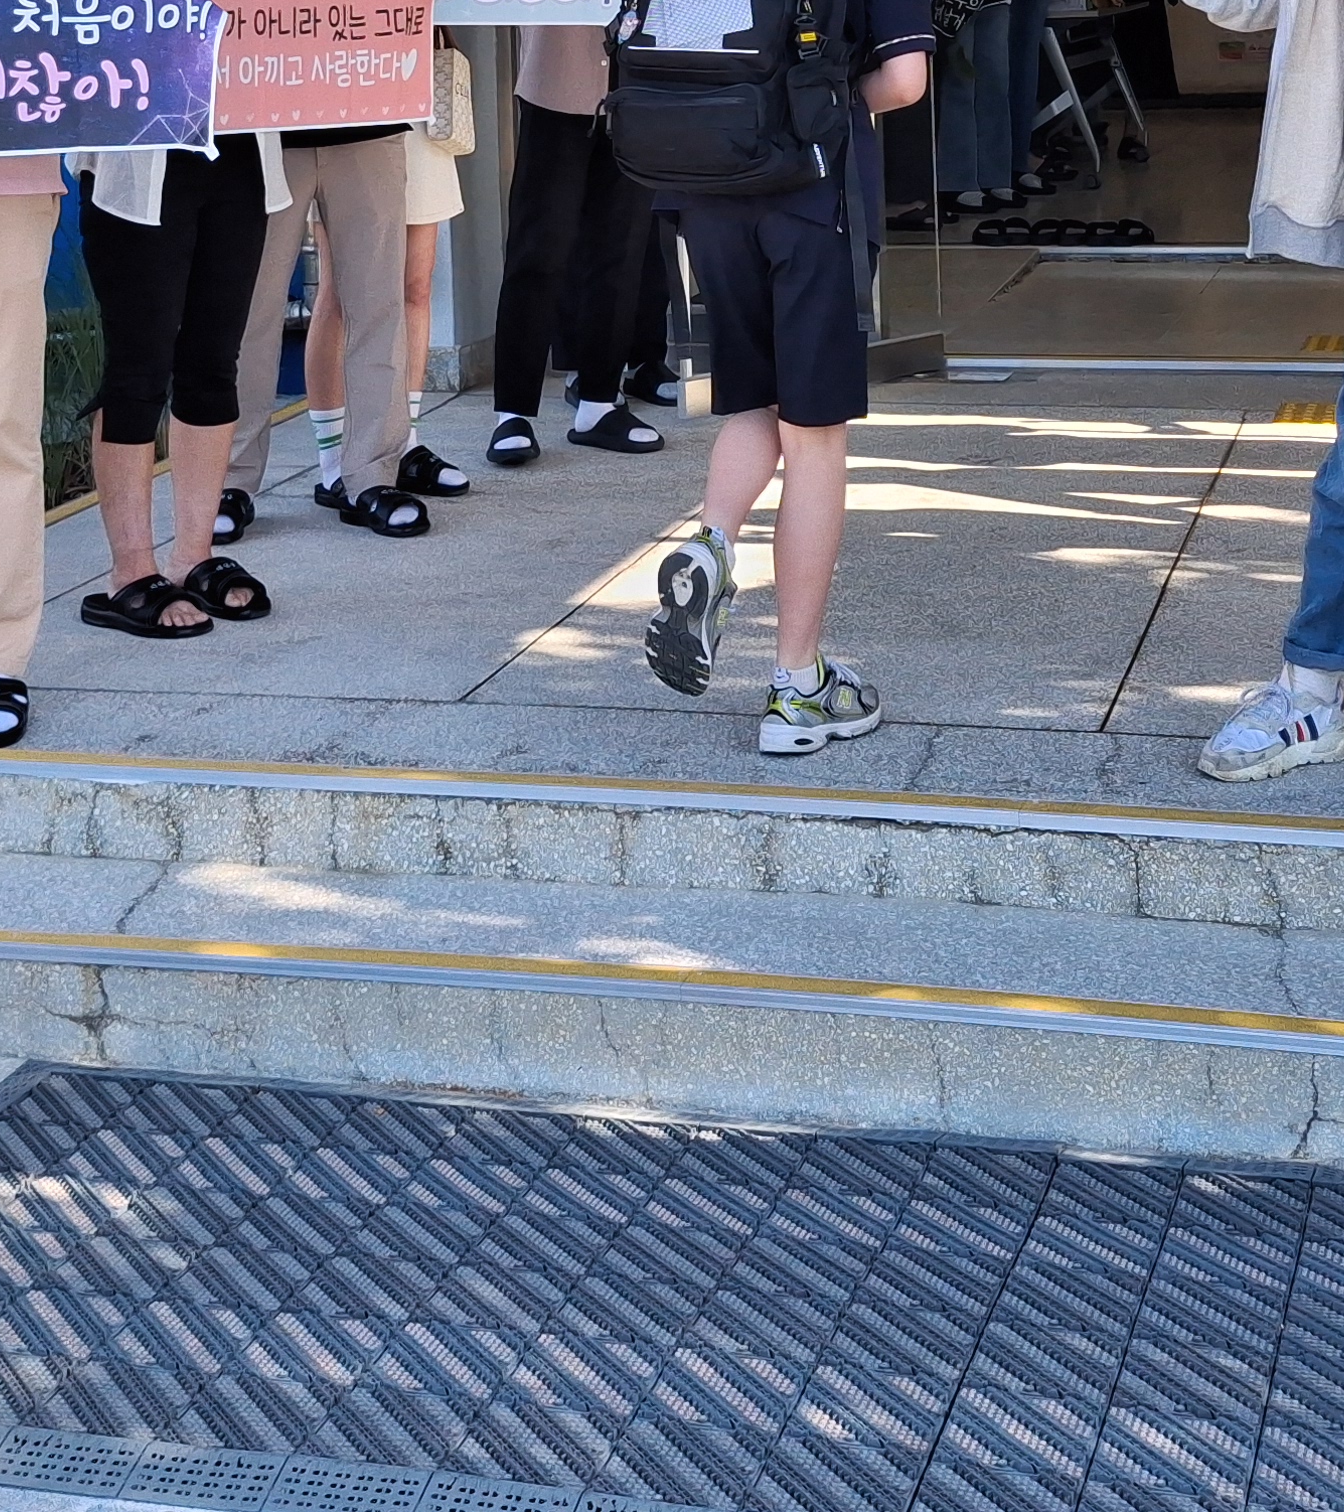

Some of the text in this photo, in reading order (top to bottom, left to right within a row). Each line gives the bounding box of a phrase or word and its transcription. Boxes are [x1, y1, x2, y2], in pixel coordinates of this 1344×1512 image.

[254, 5, 322, 39] 아니라
[328, 4, 367, 42] 있는
[374, 6, 426, 37] 그대로
[239, 53, 304, 87] 아끼고
[311, 48, 402, 88] 사랑한다
